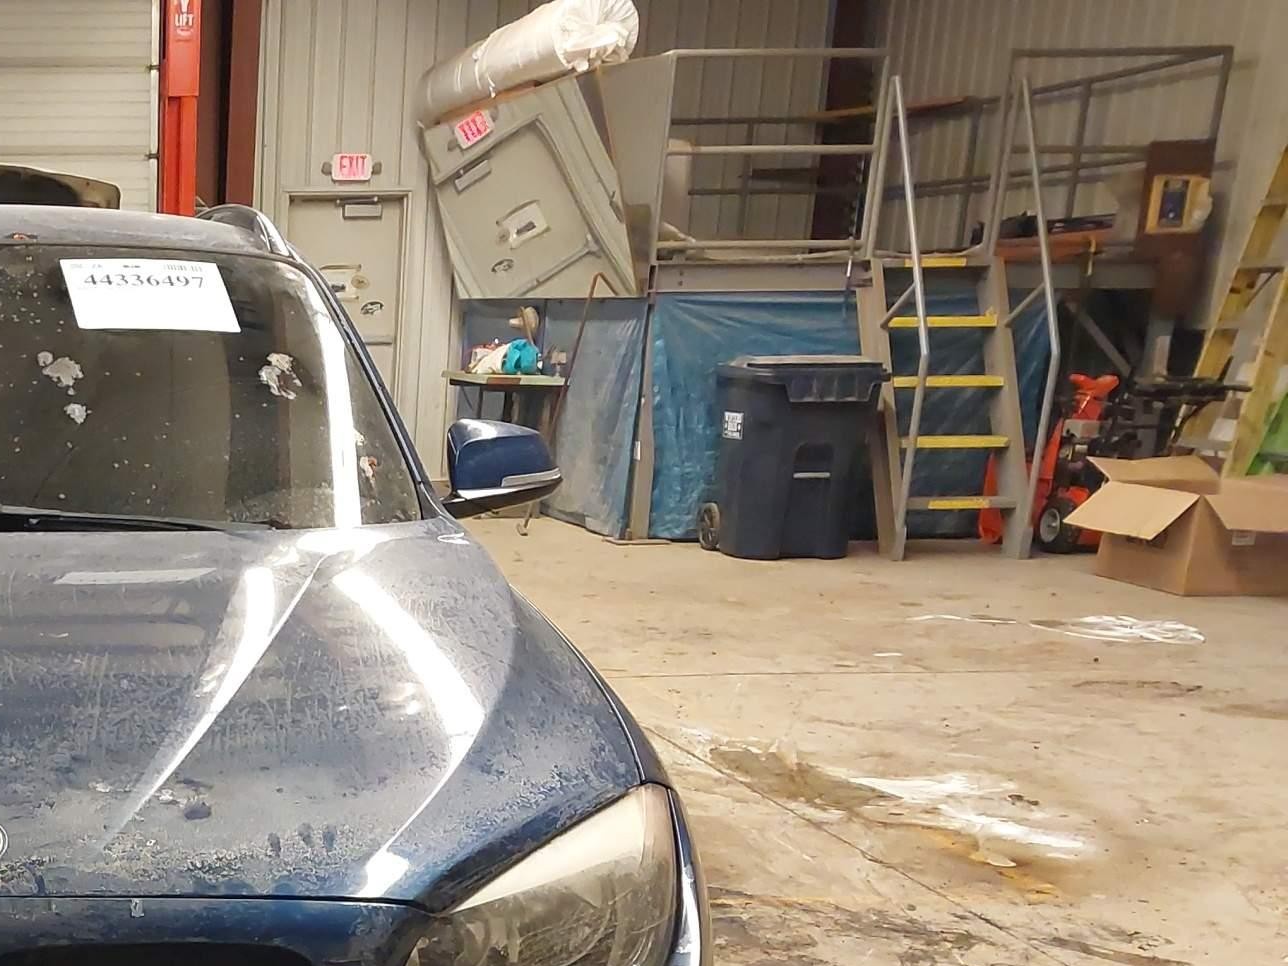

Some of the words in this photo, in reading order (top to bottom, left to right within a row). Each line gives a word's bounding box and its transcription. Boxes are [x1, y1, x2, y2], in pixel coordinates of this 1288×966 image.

[174, 13, 194, 27] LIFT
[338, 154, 367, 177] EXIT
[83, 273, 204, 289] 44336497
